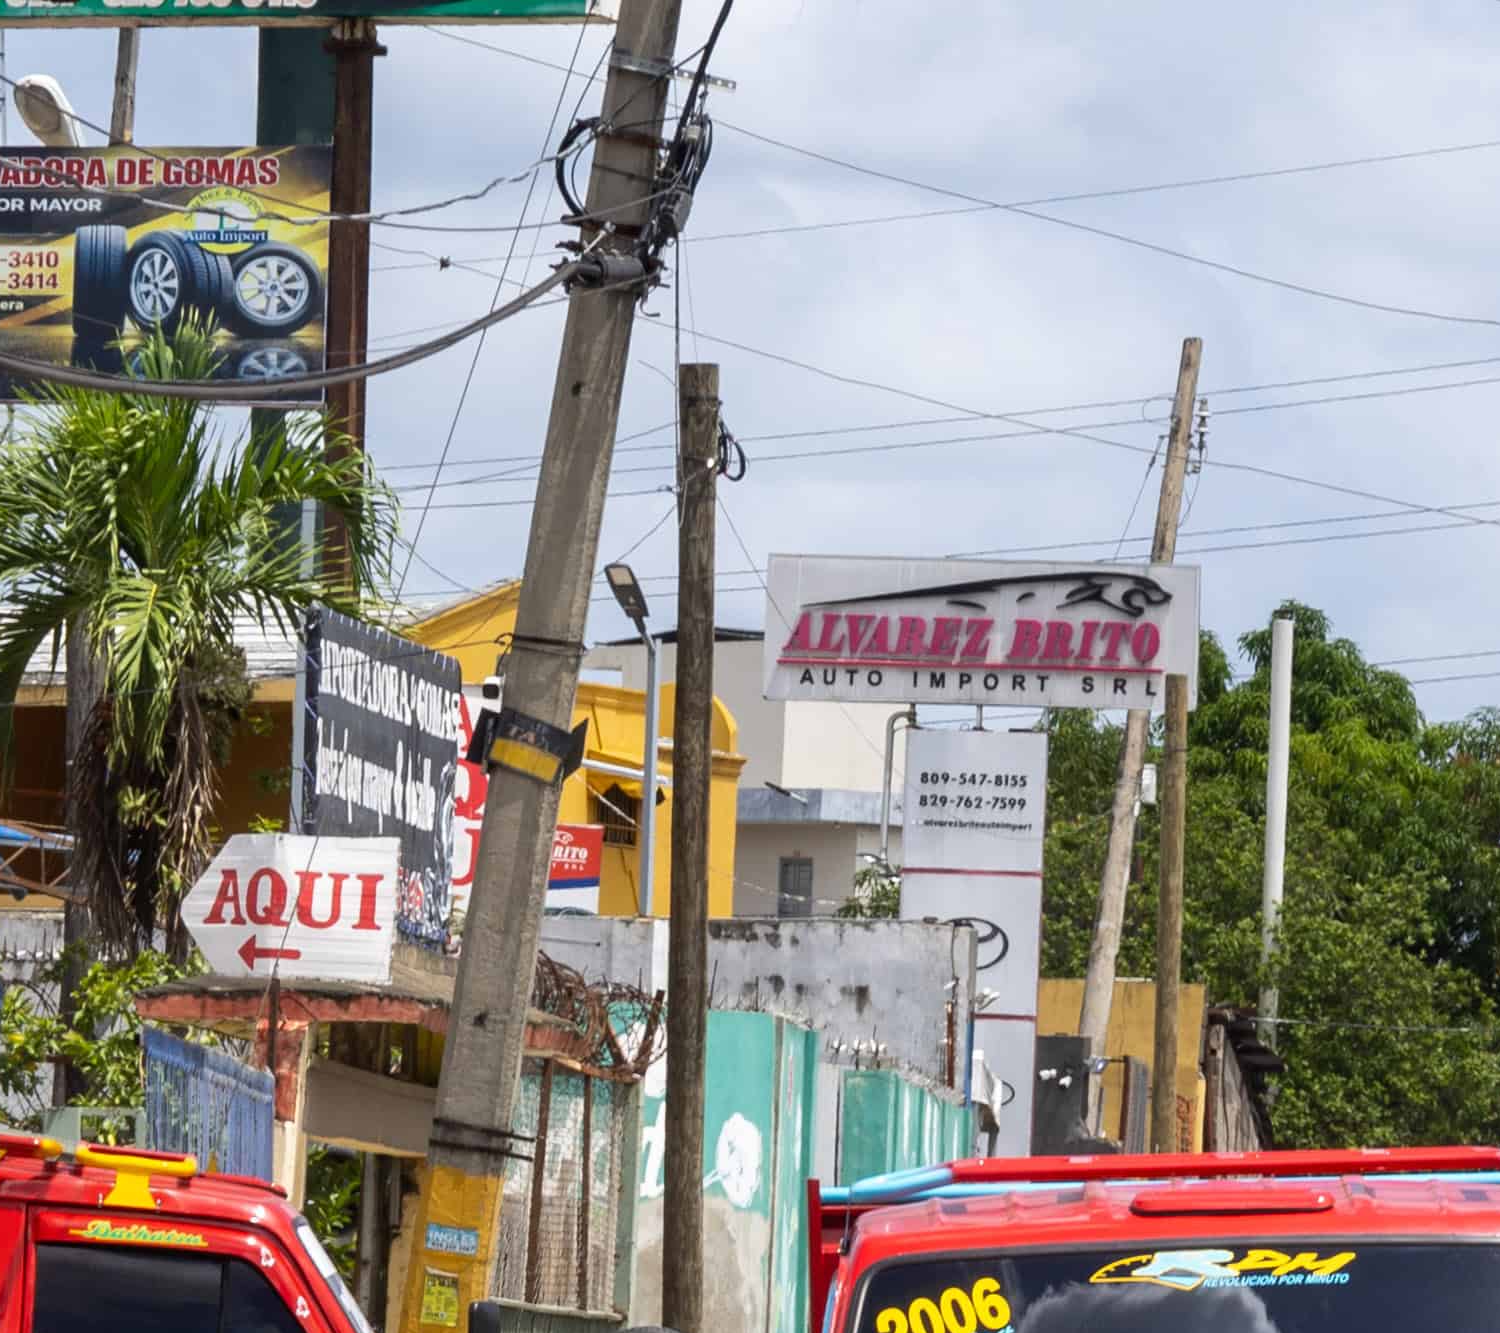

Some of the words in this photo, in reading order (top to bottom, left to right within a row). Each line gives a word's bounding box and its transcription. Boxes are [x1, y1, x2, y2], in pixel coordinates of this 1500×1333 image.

[116, 157, 154, 187] DE
[161, 157, 280, 188] GOMAS
[30, 198, 103, 213] MAYOR
[184, 230, 217, 242] Auto
[220, 230, 267, 243] Import
[782, 612, 995, 658] ALVAREZ
[1007, 618, 1161, 663] BRITO
[800, 669, 883, 687] AUTO
[913, 671, 1049, 692] IMPORT
[1081, 676, 1157, 697] SRL
[920, 771, 1029, 788] 809-547-8155
[918, 793, 1028, 811] 829-762-7599
[553, 844, 589, 861] RITO
[202, 866, 385, 931] AQUI
[86, 1219, 204, 1246] Daihatsu
[1278, 1273, 1303, 1286] POR
[1304, 1273, 1350, 1286] MINUTO
